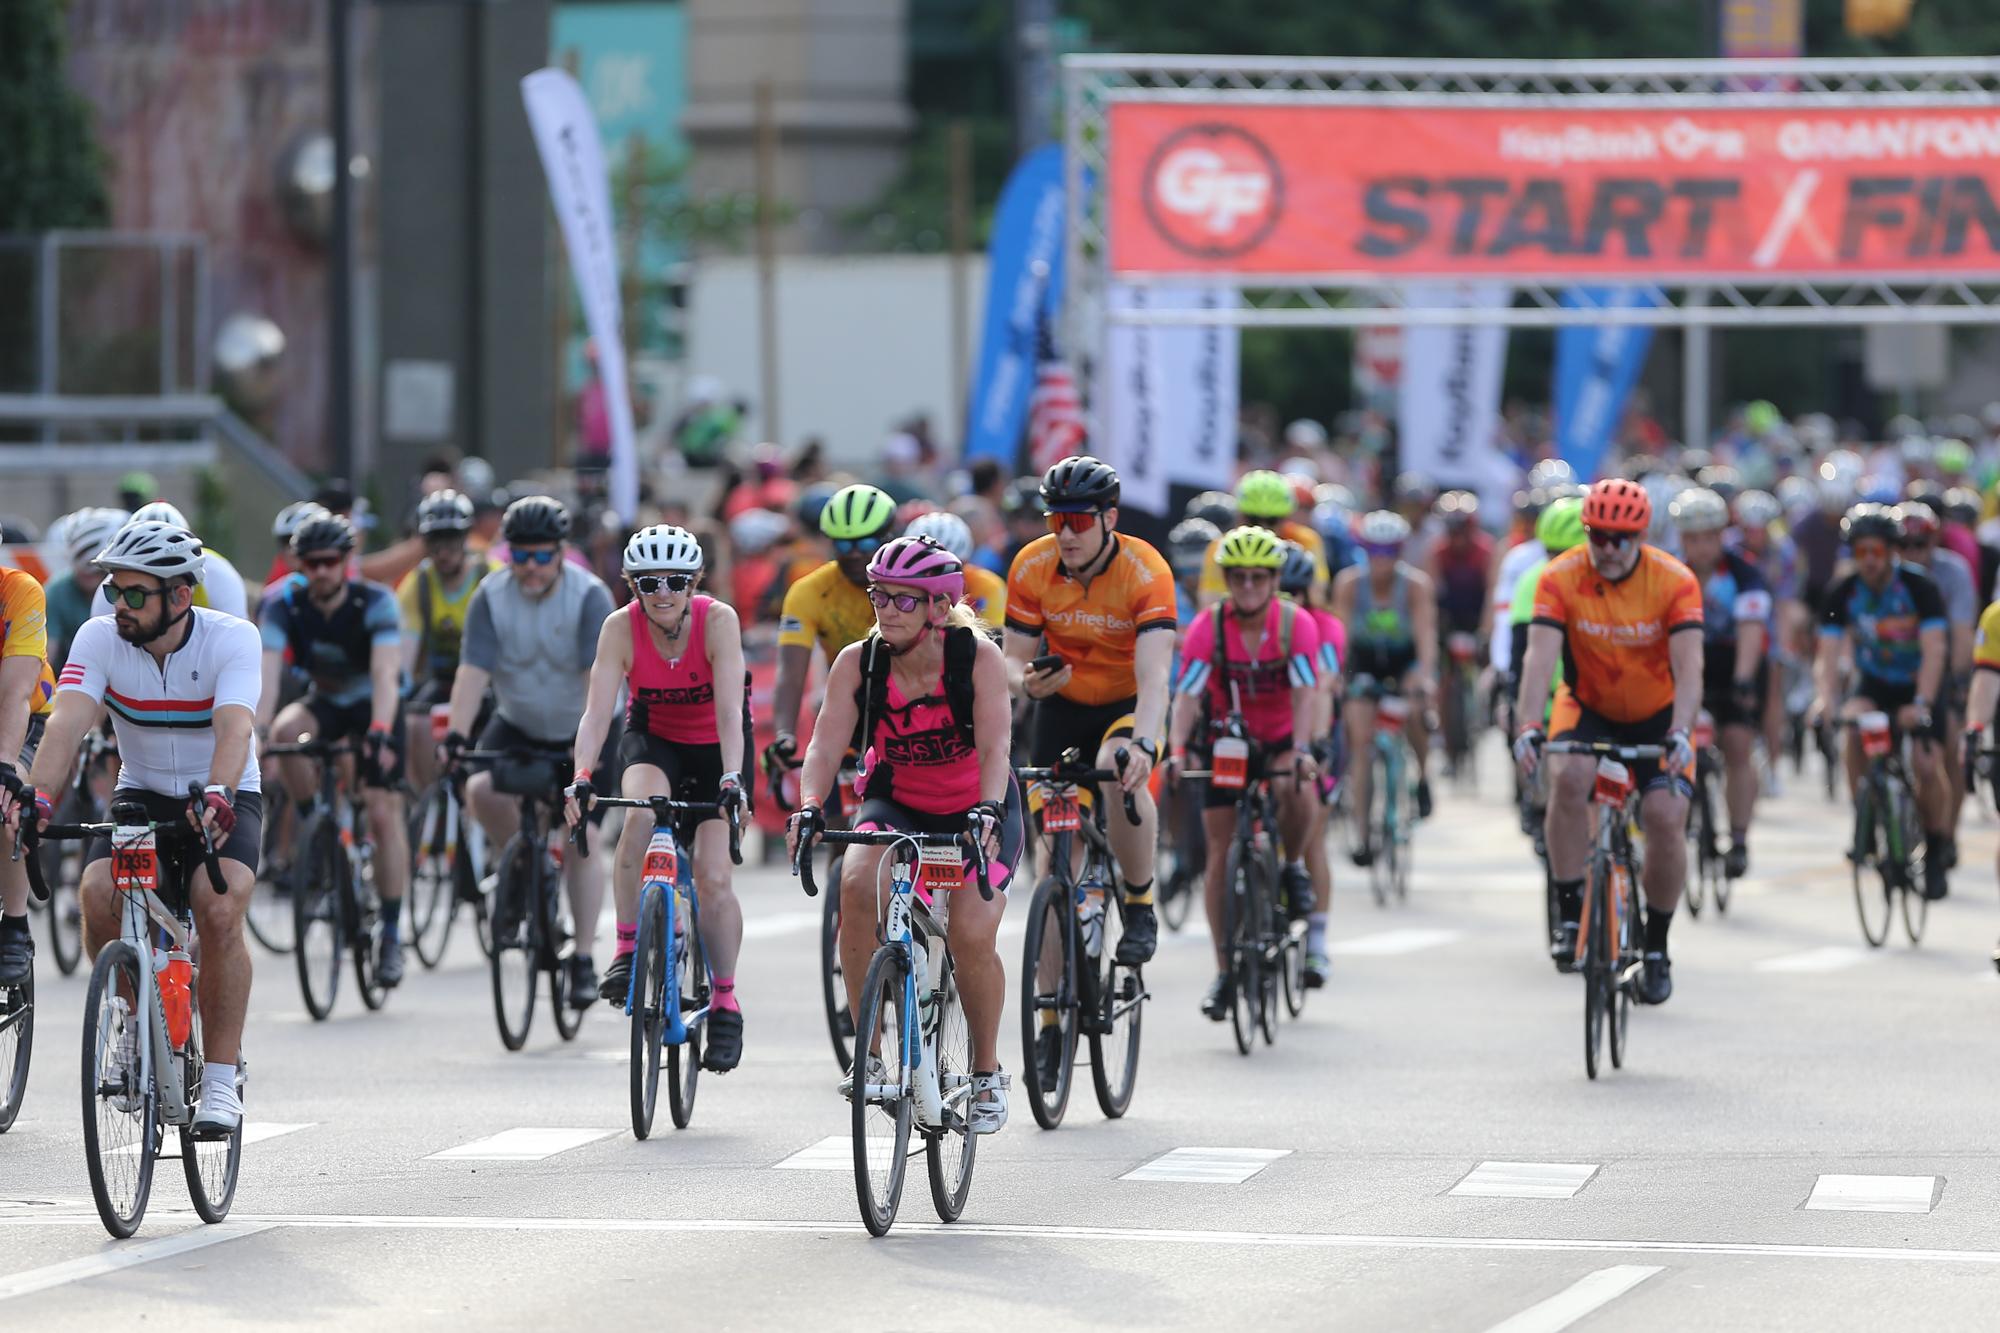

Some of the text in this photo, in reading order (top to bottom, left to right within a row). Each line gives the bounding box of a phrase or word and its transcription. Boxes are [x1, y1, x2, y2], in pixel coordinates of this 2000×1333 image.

[1356, 174, 1742, 258] START
[1838, 174, 2000, 262] FIN
[1075, 609, 1105, 626] Free
[928, 866, 956, 878] 1113
